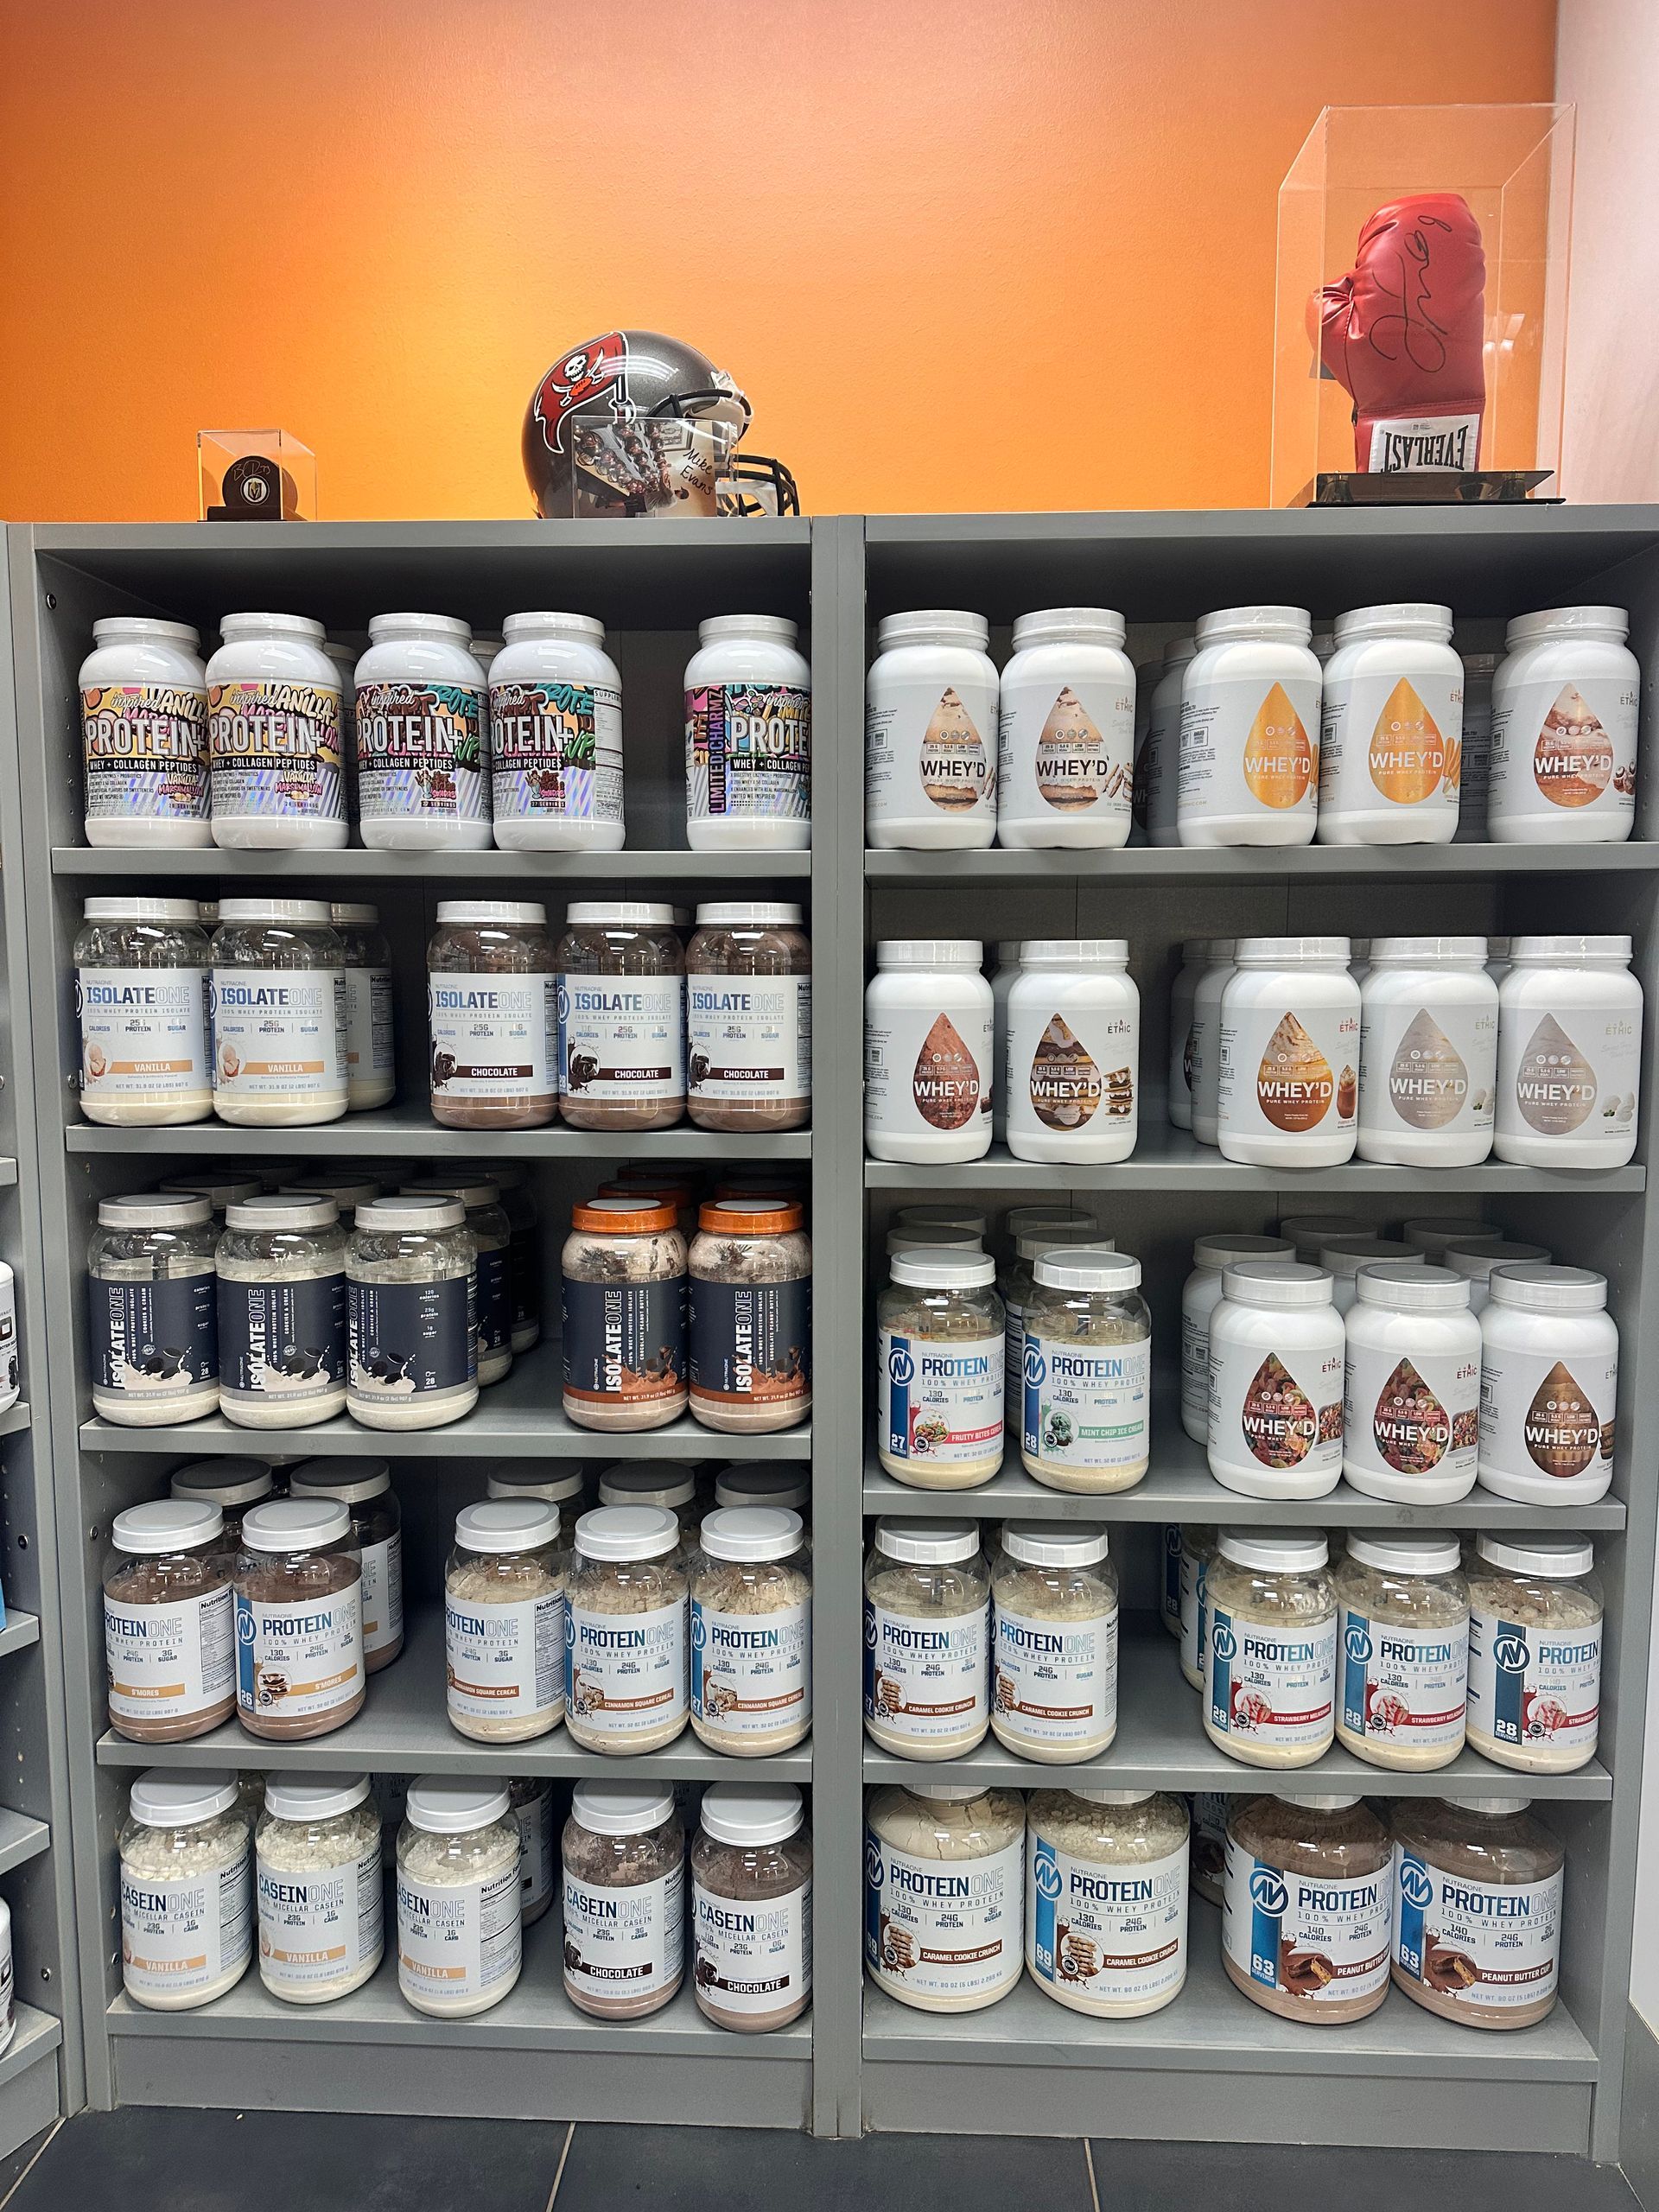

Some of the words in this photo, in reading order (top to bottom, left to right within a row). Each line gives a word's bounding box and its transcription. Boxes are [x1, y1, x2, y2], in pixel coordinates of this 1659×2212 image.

[1385, 425, 1470, 474] EVERLAST
[683, 448, 713, 476] Mike
[680, 465, 715, 496] Evans
[210, 715, 325, 755] PROTEIN+
[357, 715, 462, 753] PROTEIN+
[730, 716, 810, 757] PROTE
[113, 758, 156, 770] COLLAGEN
[159, 761, 197, 773] PEPTIDES
[232, 758, 273, 768] COLLAGEN
[276, 759, 315, 770] PEPTIDES
[373, 758, 410, 768] COLLAGEN
[413, 758, 453, 770] PEPTIDES
[495, 759, 521, 770] COLLAGEN
[524, 759, 562, 768] PEPTIDES
[734, 760, 756, 768] WHEY
[767, 760, 801, 771] COLLAGEN
[1245, 757, 1311, 773] WHEY'D
[1370, 752, 1443, 768] WHEY'D
[1535, 755, 1611, 773] WHEY'D
[921, 760, 985, 778] WHEY'D
[1037, 760, 1107, 776] WHEY'D
[1108, 1025, 1131, 1033] ETHIC
[1605, 1026, 1632, 1035] ETHIC
[268, 1064, 303, 1073] VANILLA
[471, 1068, 518, 1077] CHOCOLATE
[615, 1070, 659, 1078] CHOCOLATE
[724, 1071, 768, 1079] CHOCOLATE
[914, 1080, 979, 1096] WHEY'D
[1031, 1081, 1100, 1097] WHEY'D
[1258, 1081, 1332, 1097] WHEY'D
[1390, 1078, 1466, 1095] WHEY'D
[1517, 1083, 1595, 1100] WHEY'D
[1322, 1360, 1341, 1373] ETHIC
[1457, 1367, 1478, 1379] ETHIC
[1243, 1415, 1315, 1436] WHEY'D
[1374, 1421, 1448, 1442] WHEY'D
[892, 1433, 905, 1448] 27
[951, 1433, 974, 1441] FRUITY
[975, 1430, 990, 1439] BITES
[1025, 1433, 1037, 1449] 28
[1526, 1426, 1599, 1444] WHEY'D
[140, 1637, 183, 1647] PROTEIN
[1055, 1654, 1096, 1662] PROTEIN
[315, 1675, 342, 1690] S'MORES
[1244, 1676, 1271, 1687] CALORIES
[1380, 1678, 1408, 1688] CALORIES
[241, 1690, 252, 1705] 26
[1022, 1705, 1046, 1715] CARAMEL
[1213, 1706, 1226, 1723] 28
[1345, 1707, 1362, 1726] 28
[1496, 1719, 1517, 1737] 28
[1495, 1731, 1518, 1742] SERVINGS
[274, 1902, 308, 1912] MICELLAR
[923, 1899, 953, 1908] WHEY
[1107, 1905, 1137, 1914] WHEY
[175, 1909, 205, 1920] CASEIN
[624, 1916, 652, 1927] CASEIN
[1481, 1919, 1513, 1928] WHEY
[762, 1929, 789, 1941] CASEIN
[1299, 1932, 1332, 1942] CALORIES
[286, 1952, 328, 1962] VANILLA
[923, 1952, 953, 1961] CARAMEL
[954, 1952, 977, 1961] COOKIE
[978, 1944, 1001, 1957] CRUNCH
[1037, 1943, 1052, 1967] 69
[1106, 1957, 1136, 1966] CARAMEL
[1138, 1954, 1159, 1964] COOKIE
[1160, 1944, 1177, 1959] CRUNCH
[1401, 1944, 1420, 1968] 63
[146, 1961, 188, 1971] VANILLA
[412, 1961, 448, 1978] VANILLA
[590, 1967, 644, 1978] CHOCOLATE
[1252, 1954, 1274, 1976] 63
[1482, 1972, 1513, 1981] PEANUT
[1515, 1970, 1540, 1980] BUTTER
[1540, 1964, 1551, 1976] CUP
[1252, 1967, 1274, 1983] SERVINGS
[728, 1980, 781, 1993] CHOCOLATE
